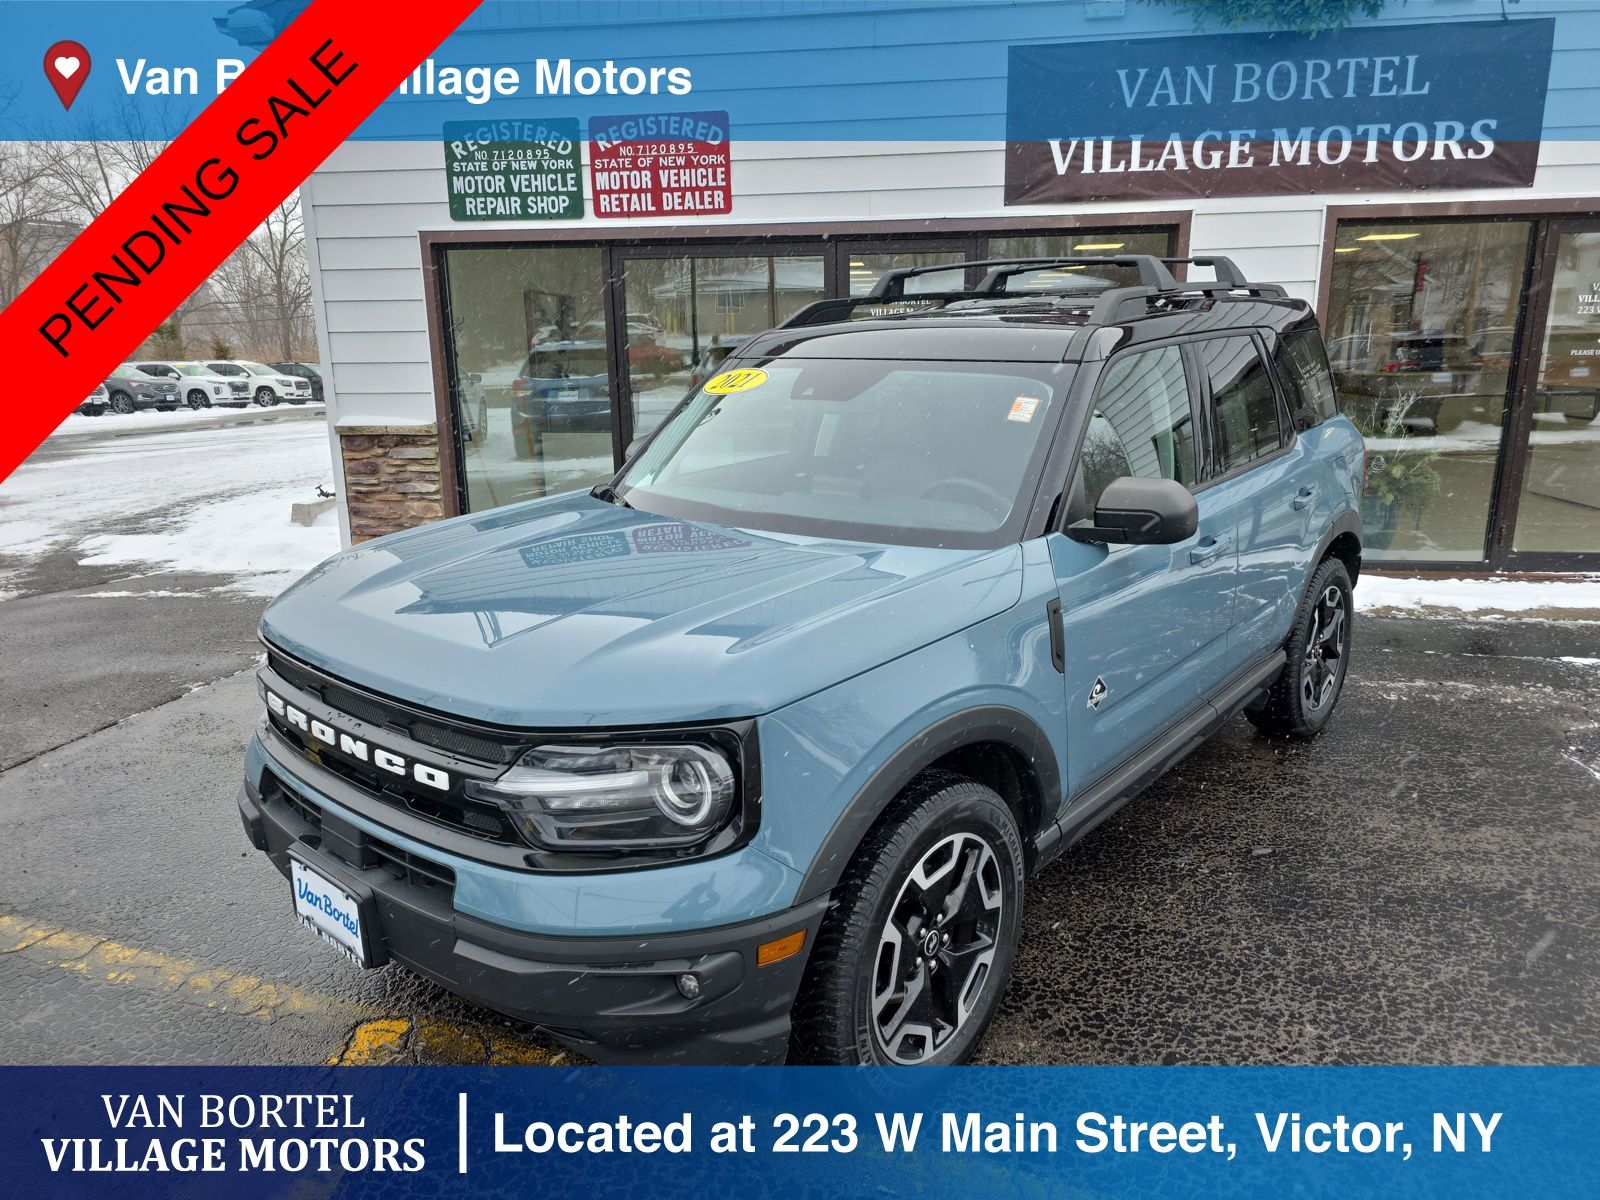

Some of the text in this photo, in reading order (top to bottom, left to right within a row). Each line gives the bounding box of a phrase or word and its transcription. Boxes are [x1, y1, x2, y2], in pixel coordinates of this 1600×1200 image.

[1116, 54, 1431, 108] VAN BORTEL
[451, 122, 573, 160] REGISTERED
[594, 115, 724, 152] REGISTERED
[492, 149, 550, 160] 7120895
[619, 143, 694, 156] NO. 7120895
[1047, 119, 1498, 176] VILLAGE MOTORS
[453, 159, 574, 172] STATE OF NEW YORK
[594, 154, 726, 169] STATE OF NEW YORK
[452, 173, 578, 194] MOTOR VEHICLE
[595, 167, 726, 190] MOTOR VEHICLE
[465, 195, 570, 216] REPAIR SHOP
[600, 190, 725, 213] RETAIL DEALER
[709, 372, 762, 390] 2021
[267, 691, 450, 791] BRONCO
